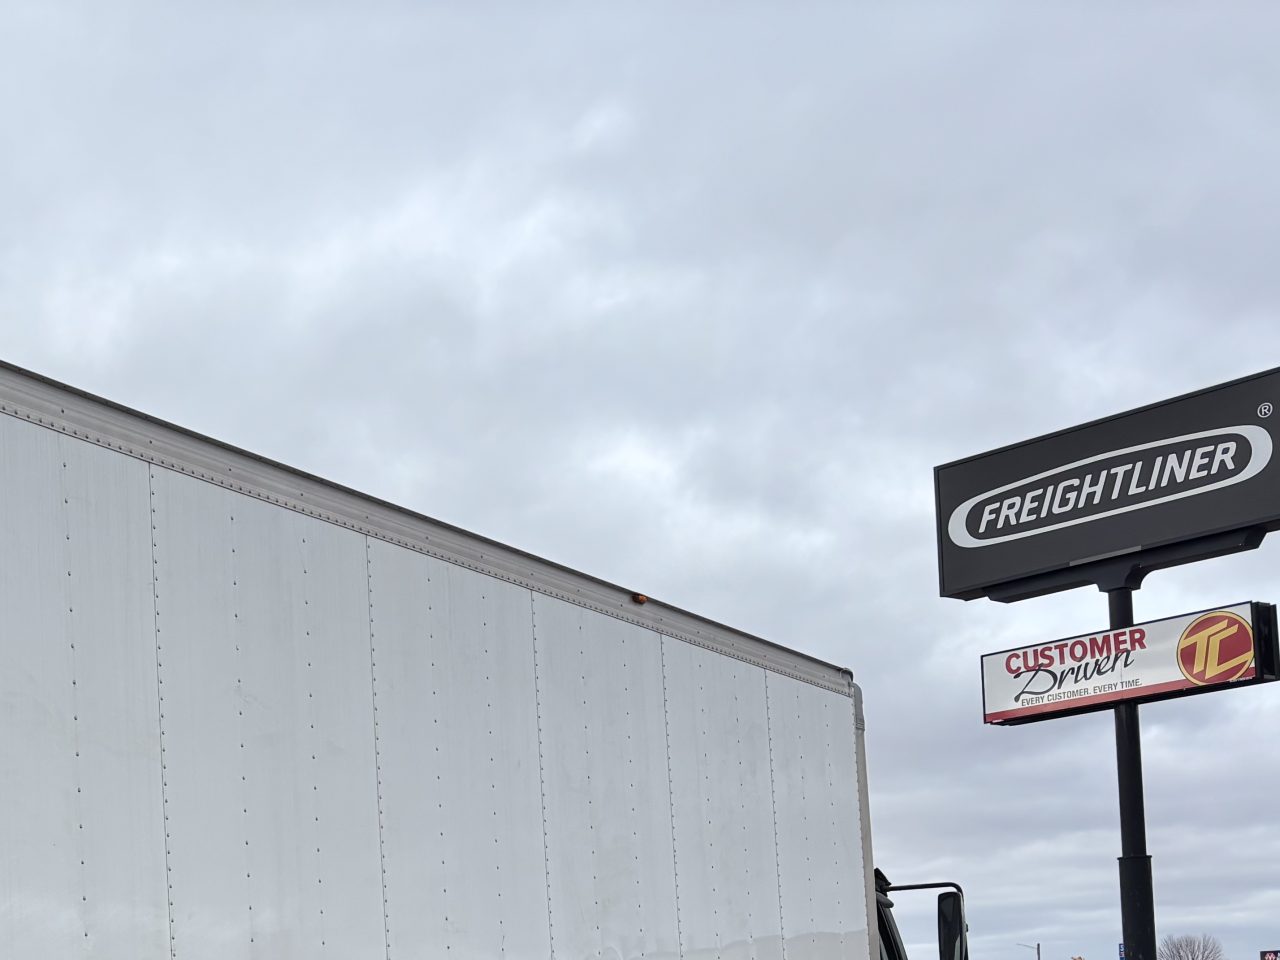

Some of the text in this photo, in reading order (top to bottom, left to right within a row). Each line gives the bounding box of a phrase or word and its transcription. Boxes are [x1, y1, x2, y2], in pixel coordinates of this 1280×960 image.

[978, 441, 1237, 533] FREIGHTLINER
[1005, 628, 1147, 675] CUSTOMER
[1013, 648, 1134, 703] Driven
[1021, 678, 1142, 707] EVERY CUSTOMER. EVERY TIME.
